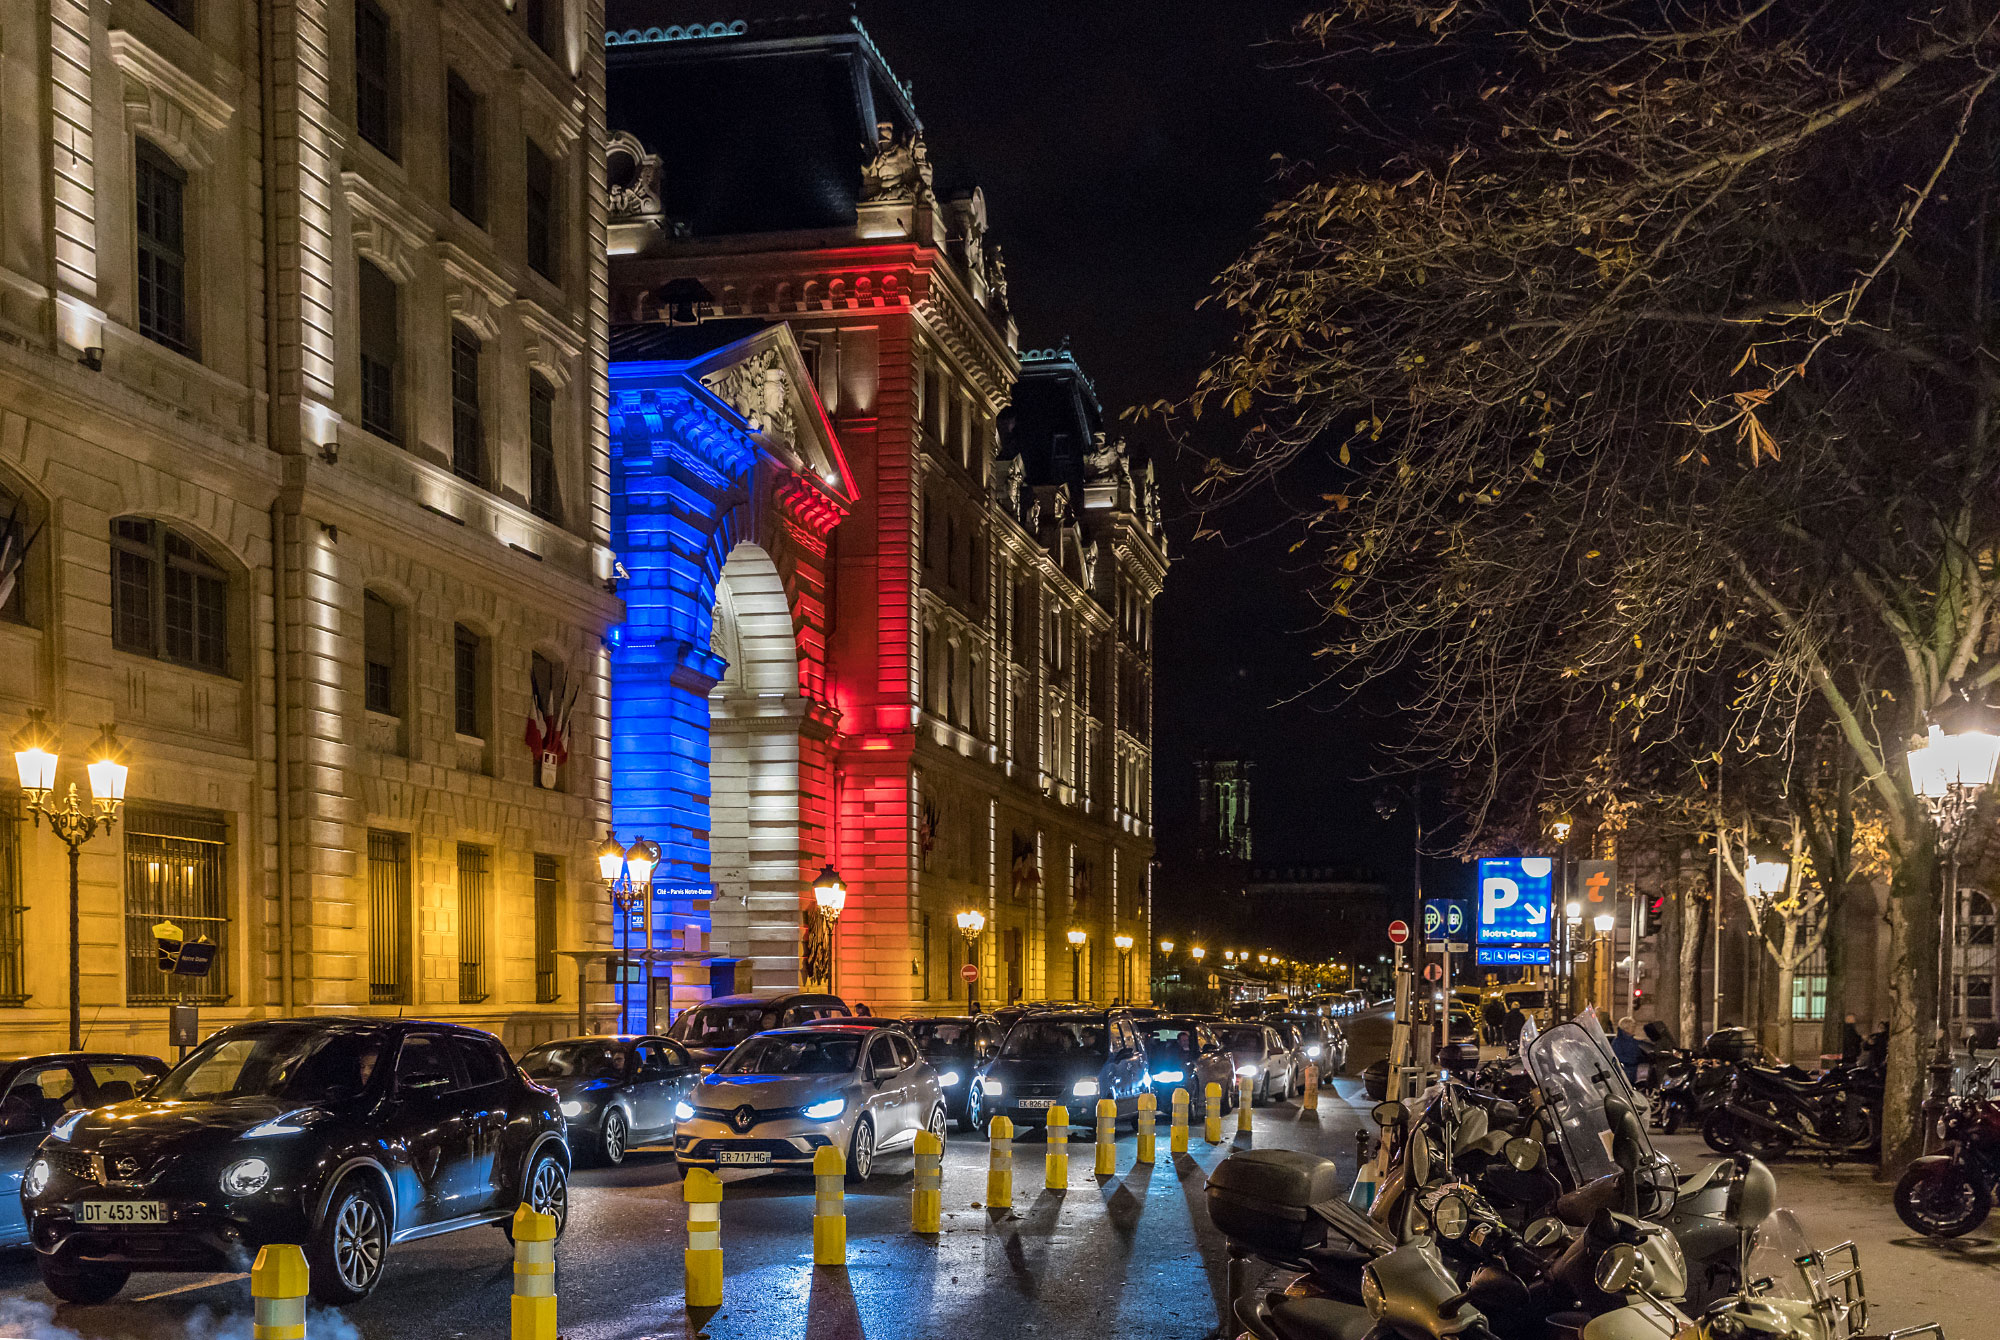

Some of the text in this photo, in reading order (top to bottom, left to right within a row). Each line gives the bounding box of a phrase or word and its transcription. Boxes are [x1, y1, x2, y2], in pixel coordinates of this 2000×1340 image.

[1482, 877, 1519, 925] P
[1482, 929, 1537, 938] Notre-Dame
[721, 1153, 765, 1162] ER-717-HG
[85, 1204, 158, 1221] DT-453-SN
